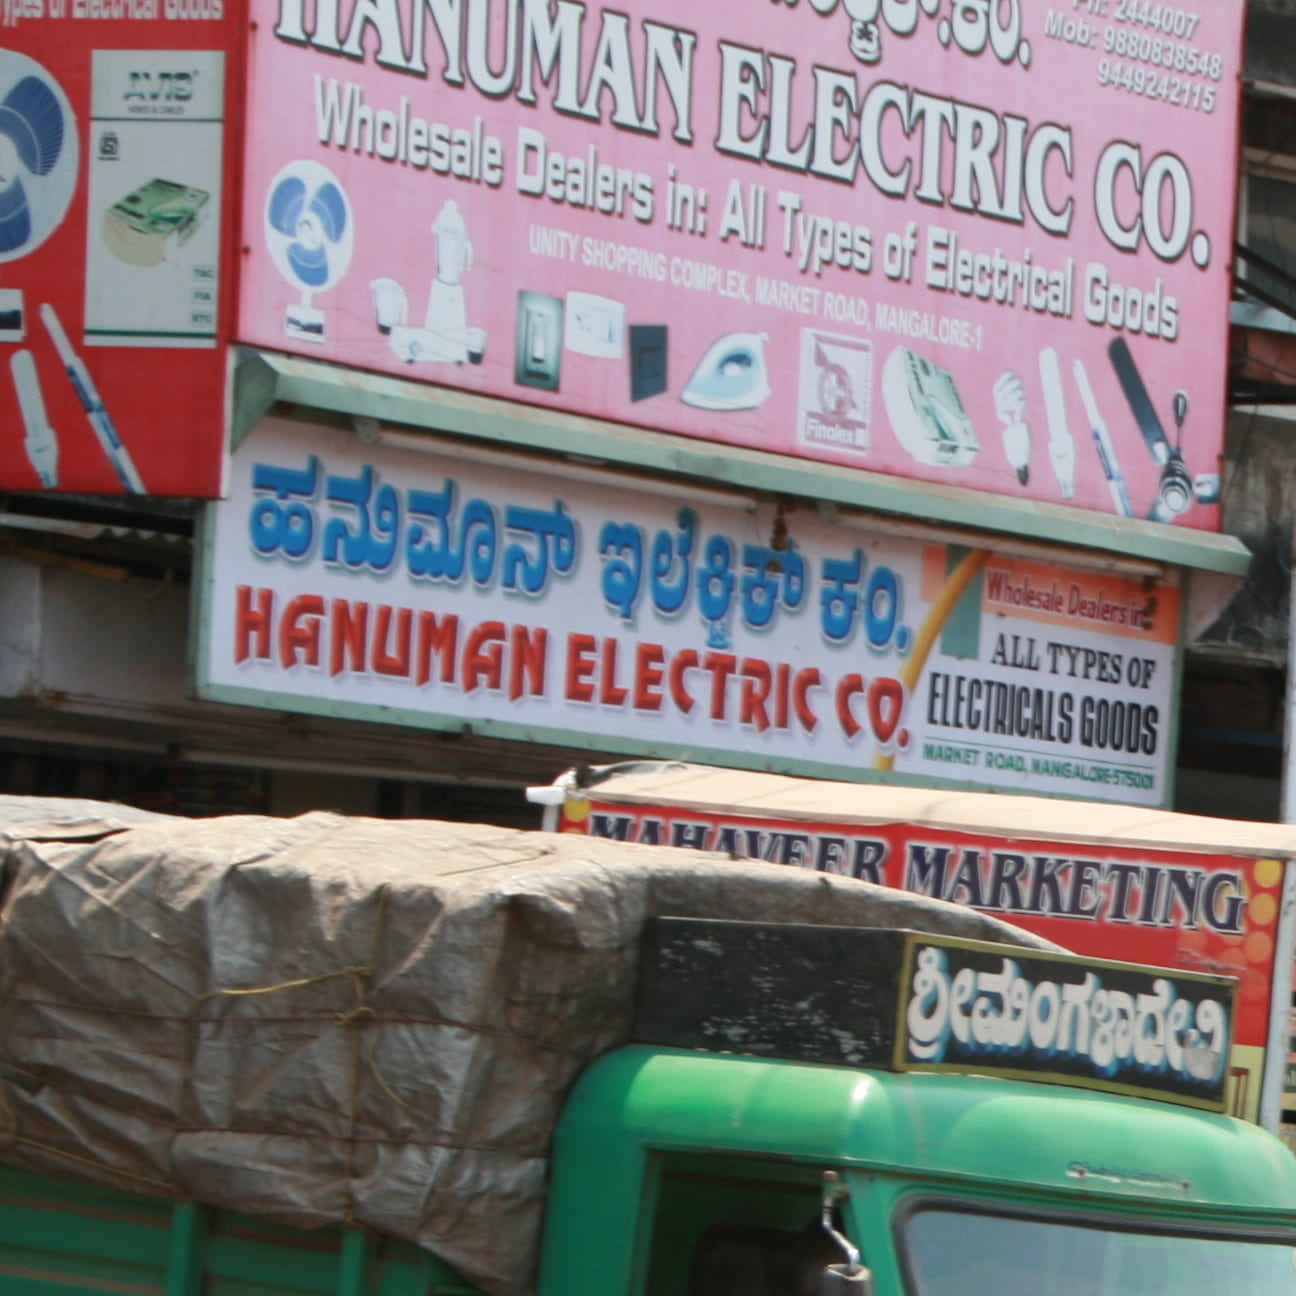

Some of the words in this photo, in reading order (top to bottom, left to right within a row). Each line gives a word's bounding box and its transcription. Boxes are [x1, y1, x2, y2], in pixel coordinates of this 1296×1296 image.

[1044, 10, 1097, 53] Mob:
[1102, 26, 1223, 82] 9880838548
[1098, 57, 1217, 114] 9449242115
[715, 40, 1075, 235] ELECTRIC
[1094, 138, 1211, 269] CO.
[313, 73, 504, 186] Wholesale
[517, 126, 655, 223] Dealers
[666, 164, 708, 236] in:
[719, 178, 765, 247] All
[778, 189, 873, 278] Types
[883, 219, 917, 282] of
[925, 229, 1073, 318] Electrical
[1083, 261, 1179, 342] Goods
[529, 224, 579, 263] UNITY
[581, 236, 667, 285] SHOPPING
[670, 255, 751, 305] COMPLEX,
[755, 274, 821, 319] MARKET
[824, 290, 872, 334] ROAD,
[875, 302, 984, 353] MANGALORE-1
[248, 454, 577, 594] ಹನುಮಾನ್
[984, 570, 1064, 614] Wholesale
[1067, 583, 1126, 626] Dealers
[235, 584, 549, 702] HANUMAN
[566, 632, 821, 735] ELECTRIC
[834, 672, 911, 749] CO.
[991, 632, 1042, 672] ALL
[1046, 641, 1123, 685] TYPES
[1126, 655, 1157, 690] OF
[926, 671, 1074, 743] ELECTRICALS
[1079, 697, 1160, 757] GOODS
[922, 742, 980, 769] MARKET
[984, 749, 1030, 778] ROAD,
[904, 841, 1248, 937] MARKETING
